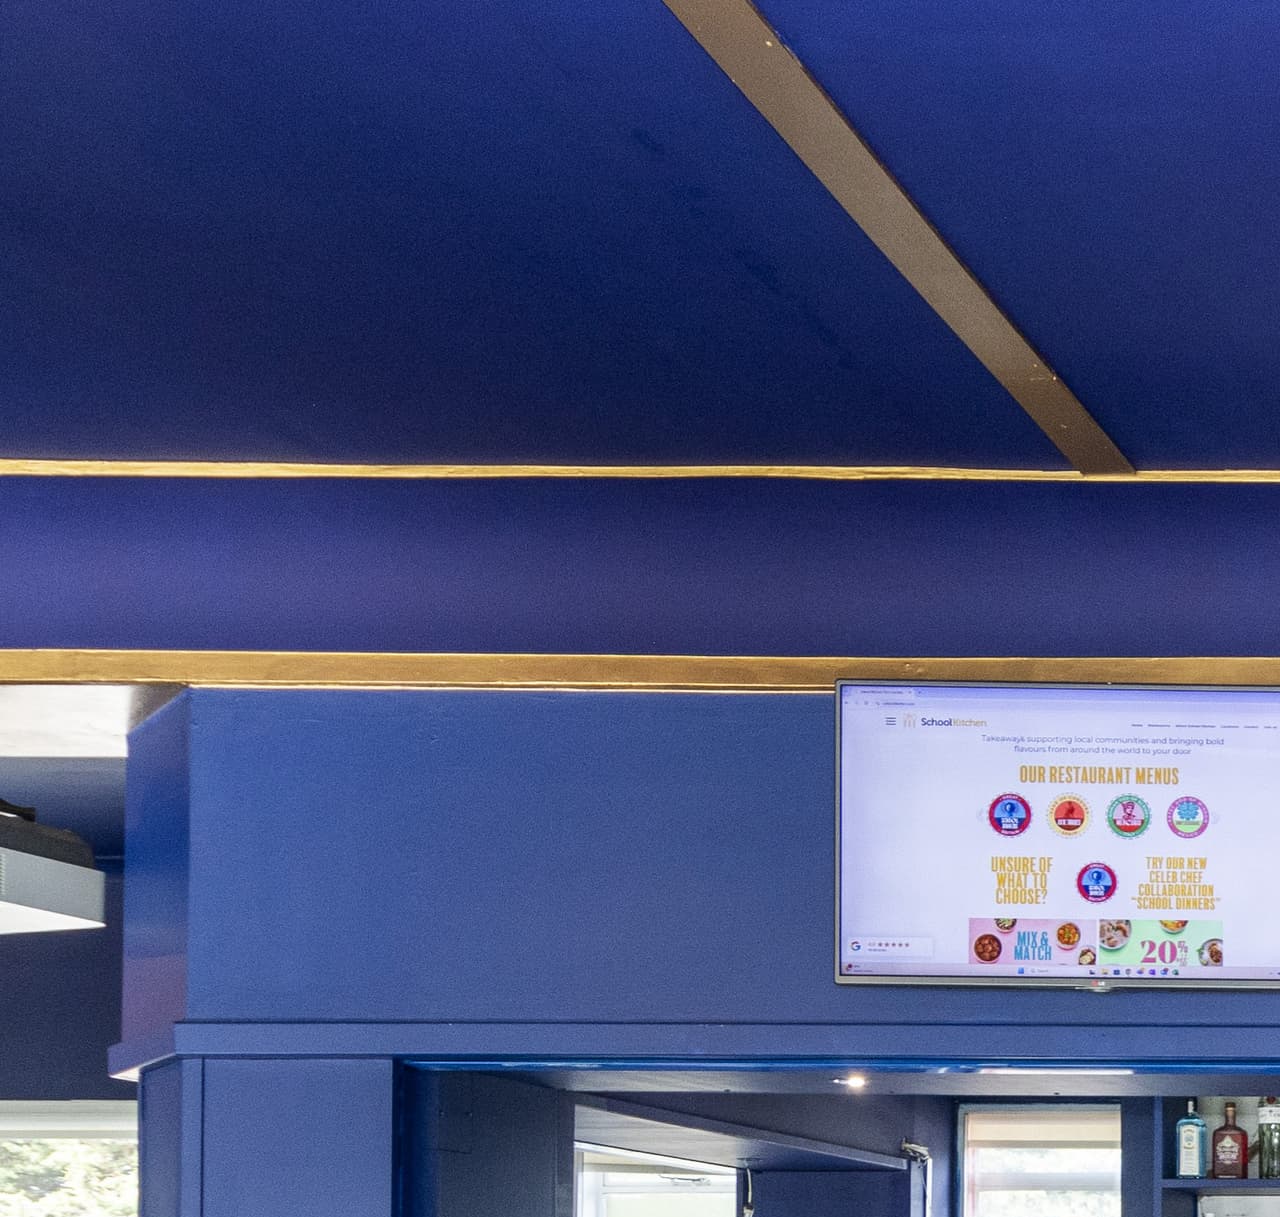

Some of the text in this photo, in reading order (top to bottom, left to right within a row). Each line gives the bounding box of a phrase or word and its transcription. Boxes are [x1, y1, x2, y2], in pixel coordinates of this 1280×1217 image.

[981, 735, 1224, 747] Takeaways supporting local communities and bringing bold
[1014, 745, 1046, 754] flavours
[1048, 745, 1068, 754] from
[1070, 746, 1100, 754] around
[1101, 746, 1116, 754] the
[1118, 747, 1140, 755] world
[1152, 749, 1171, 757] your
[1172, 748, 1191, 756] door
[1020, 765, 1179, 786] OUR RESTAURANT MENUS
[991, 856, 1054, 873] UNSURE OF
[1146, 856, 1207, 870] TRY OUR NEW
[996, 872, 1048, 889] WHAT TO
[1149, 870, 1203, 884] CELEB CHEF
[996, 888, 1048, 905] CHOOSE?
[1138, 884, 1214, 898] COLLABORATION
[1017, 932, 1048, 947] MIX &
[1014, 946, 1052, 962] MATCH
